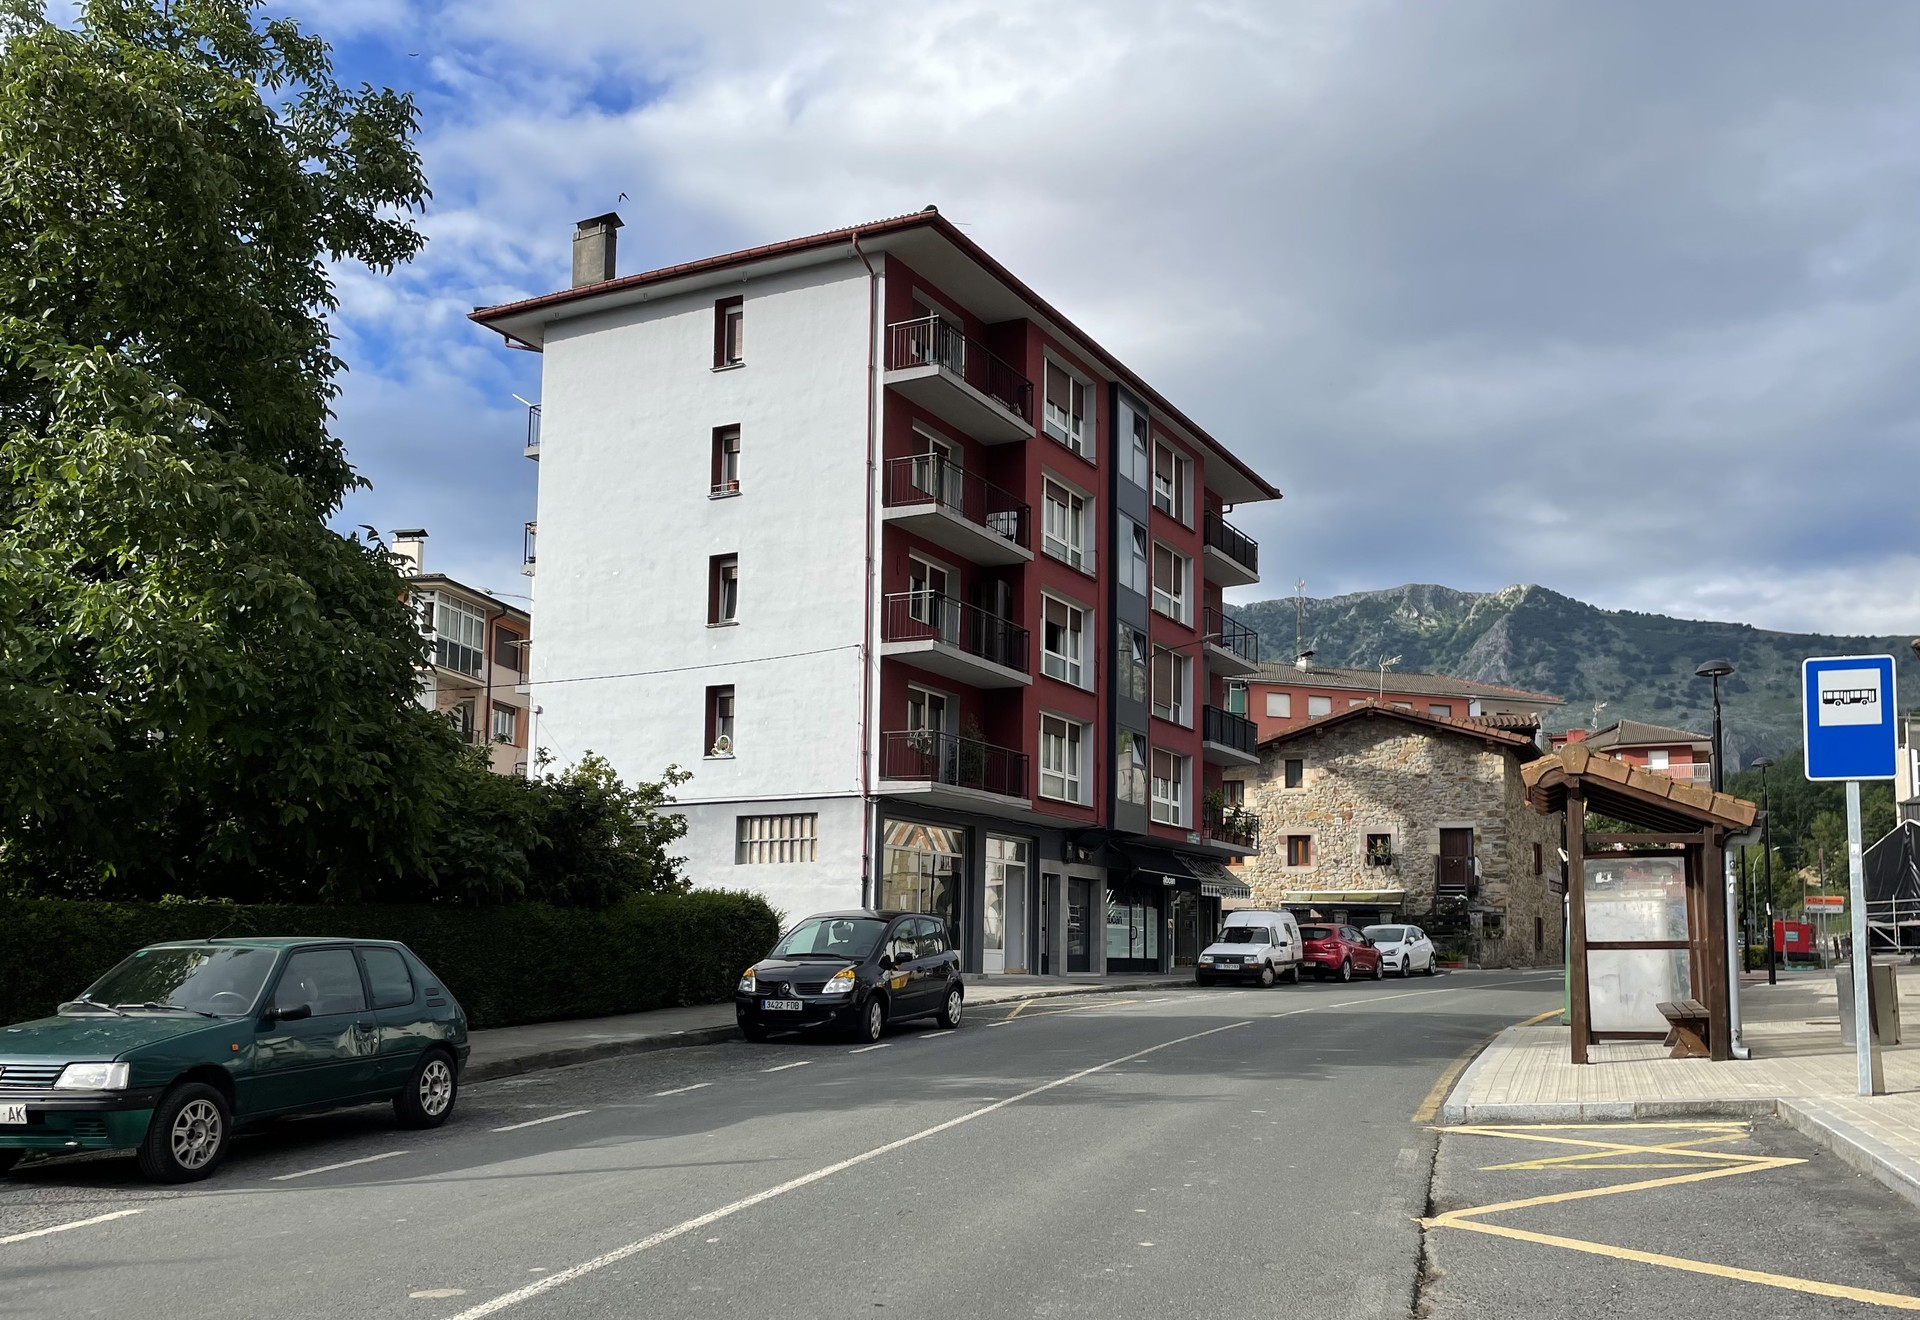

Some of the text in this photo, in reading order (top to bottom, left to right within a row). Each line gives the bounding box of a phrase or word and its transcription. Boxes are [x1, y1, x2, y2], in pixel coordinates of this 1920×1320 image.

[766, 1000, 800, 1010] 3422 FDB
[8, 1106, 25, 1122] AK
